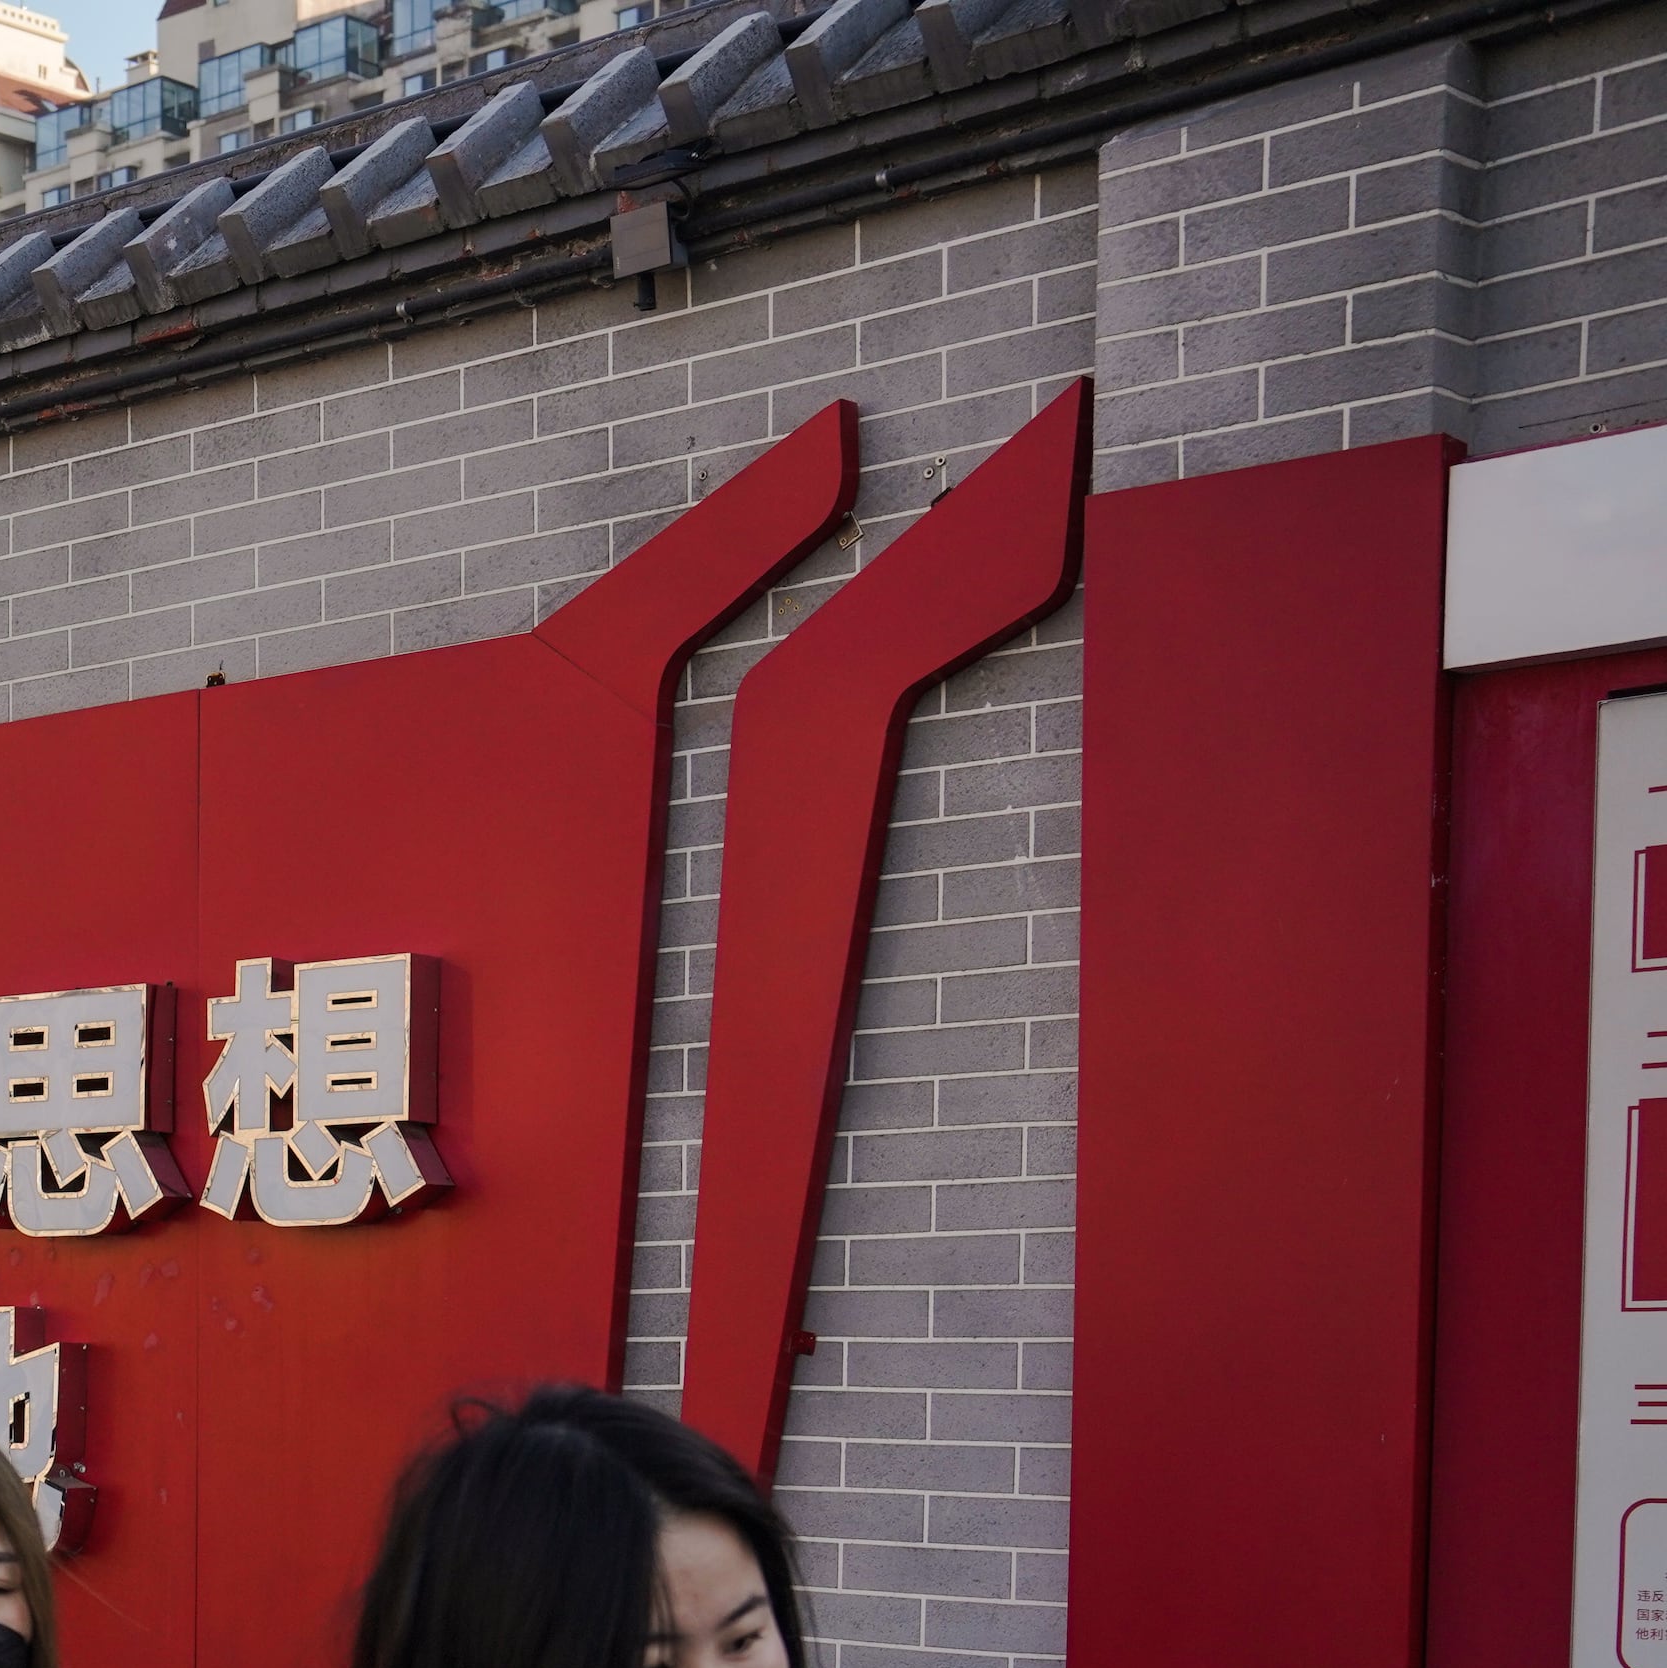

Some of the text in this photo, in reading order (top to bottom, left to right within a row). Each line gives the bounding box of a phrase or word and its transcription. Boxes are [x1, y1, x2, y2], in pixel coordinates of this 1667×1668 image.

[1637, 1590, 1665, 1603] 违反
[1637, 1608, 1667, 1622] 国家
[1635, 1627, 1667, 1641] 他利
